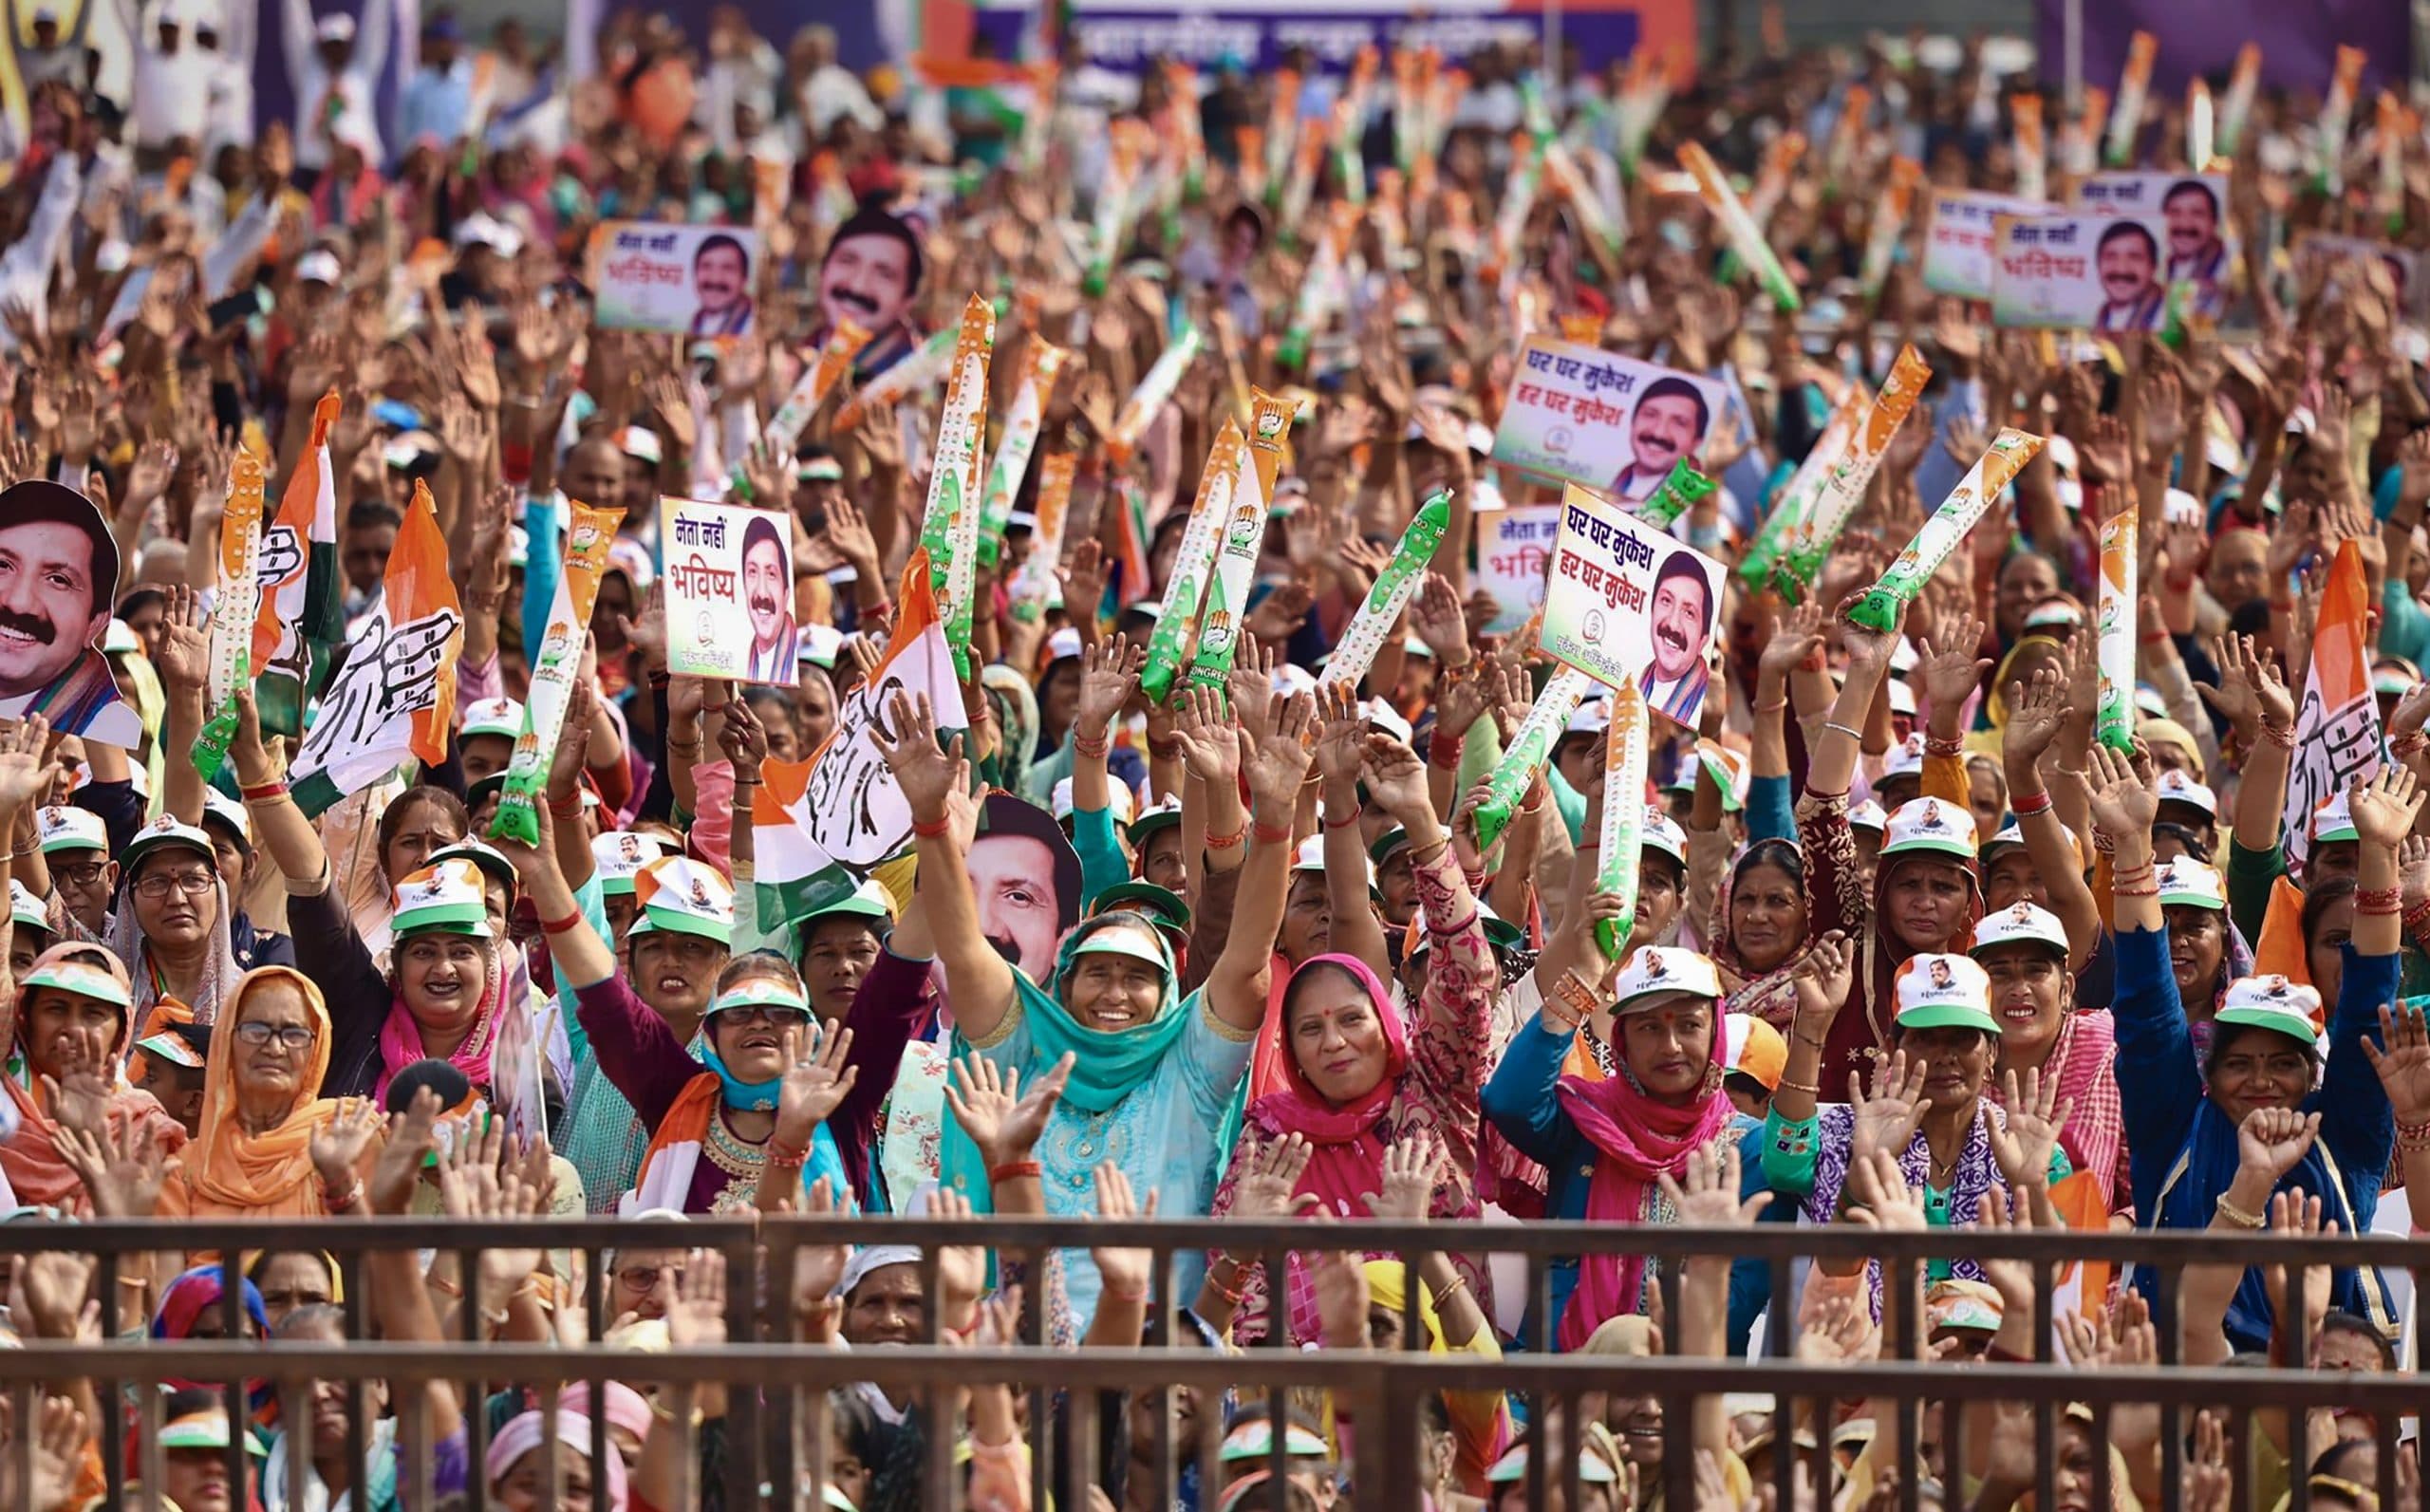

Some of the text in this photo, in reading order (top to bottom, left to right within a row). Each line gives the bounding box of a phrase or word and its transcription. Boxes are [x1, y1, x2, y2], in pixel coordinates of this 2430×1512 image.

[1526, 348, 1636, 394] घर घर मुकेश
[1516, 383, 1625, 426] हर घर मुकेश
[675, 512, 727, 550] नेता नहीं
[1499, 515, 1537, 539] नेता
[1568, 504, 1655, 571] घर घर मुकेश
[671, 553, 736, 604] भविष्य
[1560, 548, 1648, 615] हर घर मुकेश
